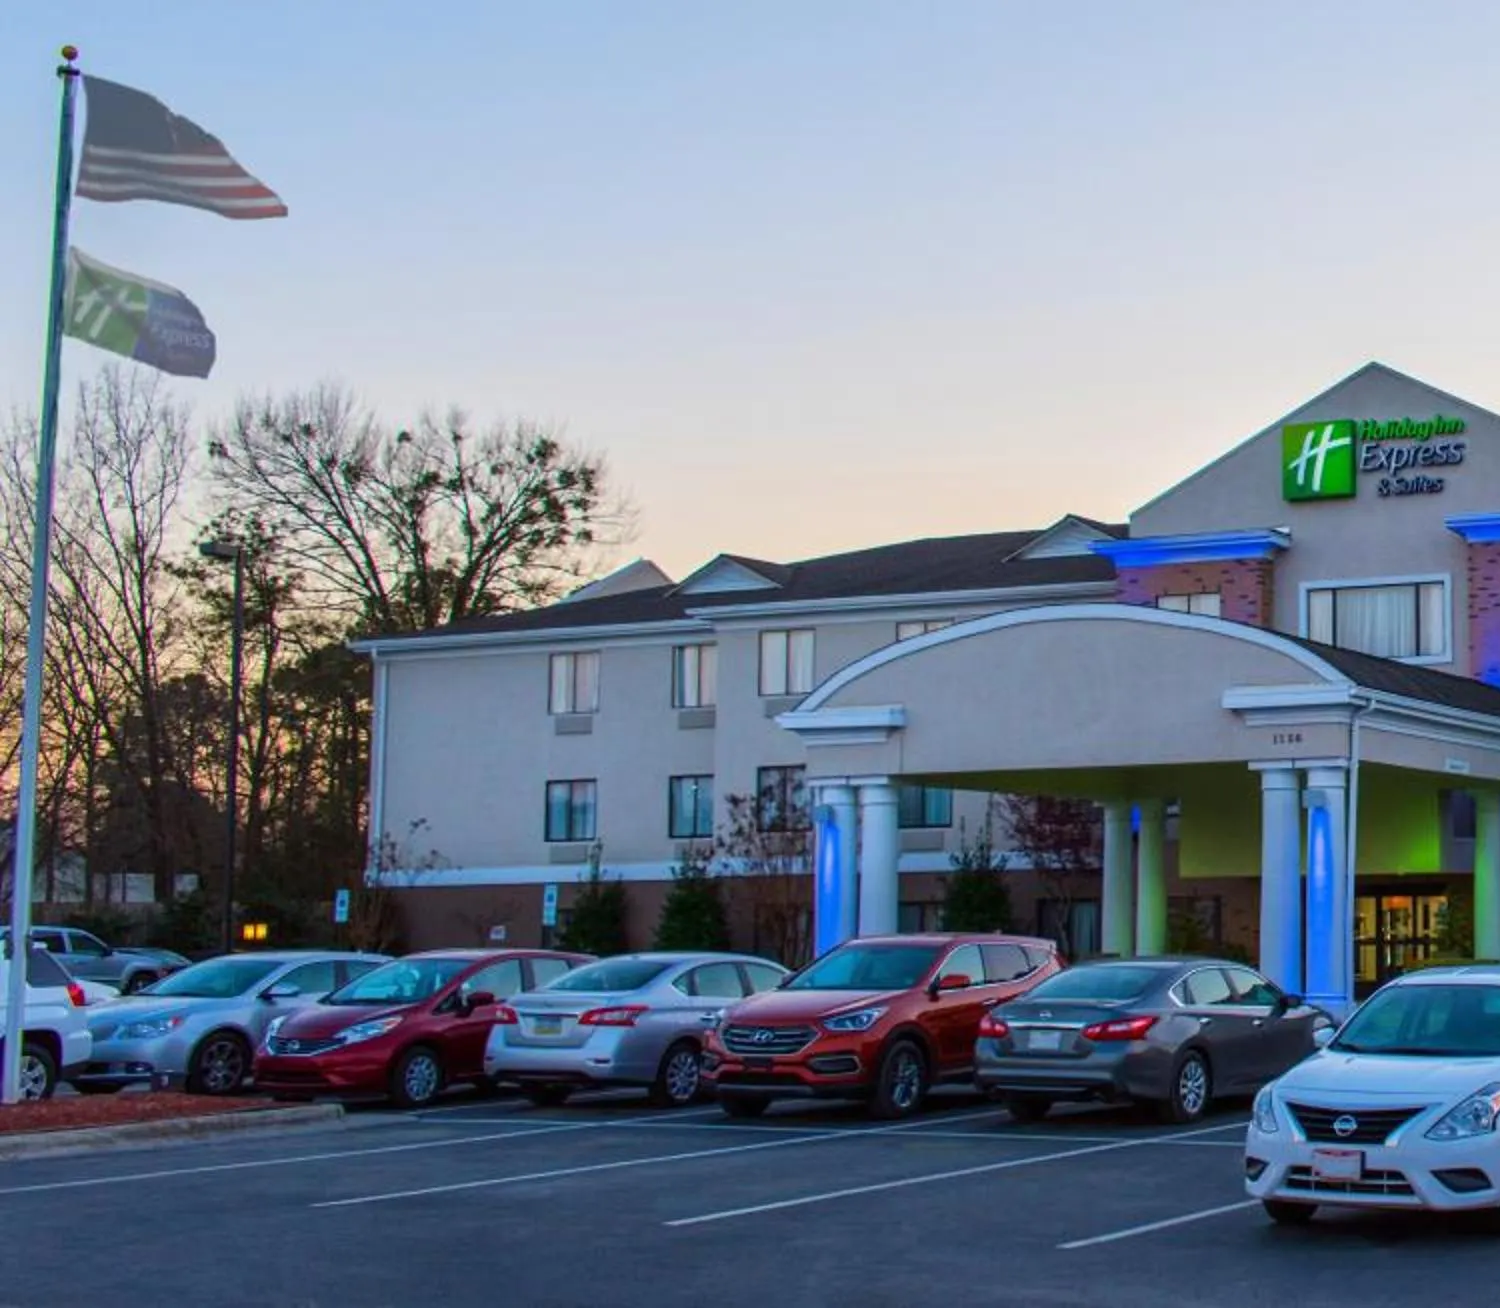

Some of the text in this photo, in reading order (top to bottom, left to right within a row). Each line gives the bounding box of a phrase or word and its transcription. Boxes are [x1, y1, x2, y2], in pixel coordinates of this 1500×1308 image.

[1360, 413, 1465, 441] Holiday Inn
[1359, 441, 1466, 476] Express
[1377, 474, 1445, 497] & Suites
